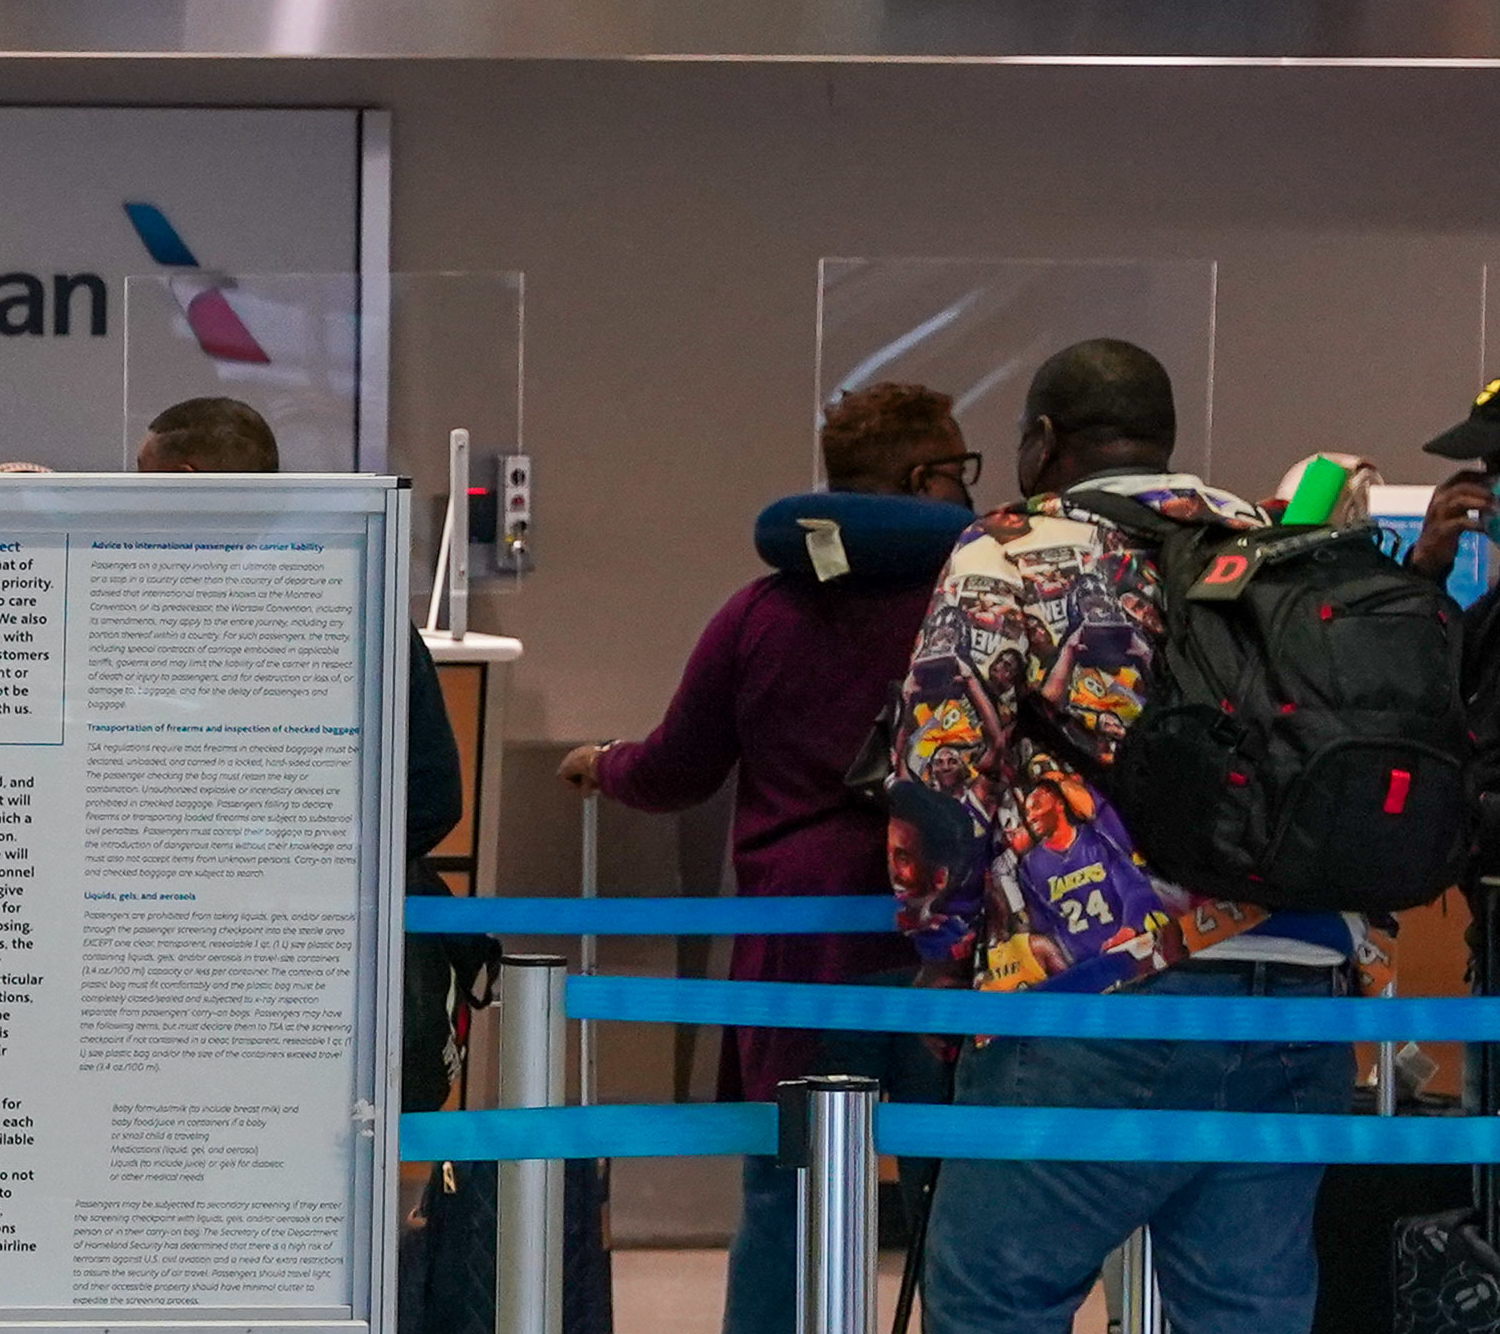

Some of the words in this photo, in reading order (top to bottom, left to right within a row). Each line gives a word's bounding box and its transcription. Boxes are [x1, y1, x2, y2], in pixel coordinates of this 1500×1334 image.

[1204, 555, 1248, 584] D
[20, 612, 47, 625] also
[1059, 889, 1115, 935] 24
